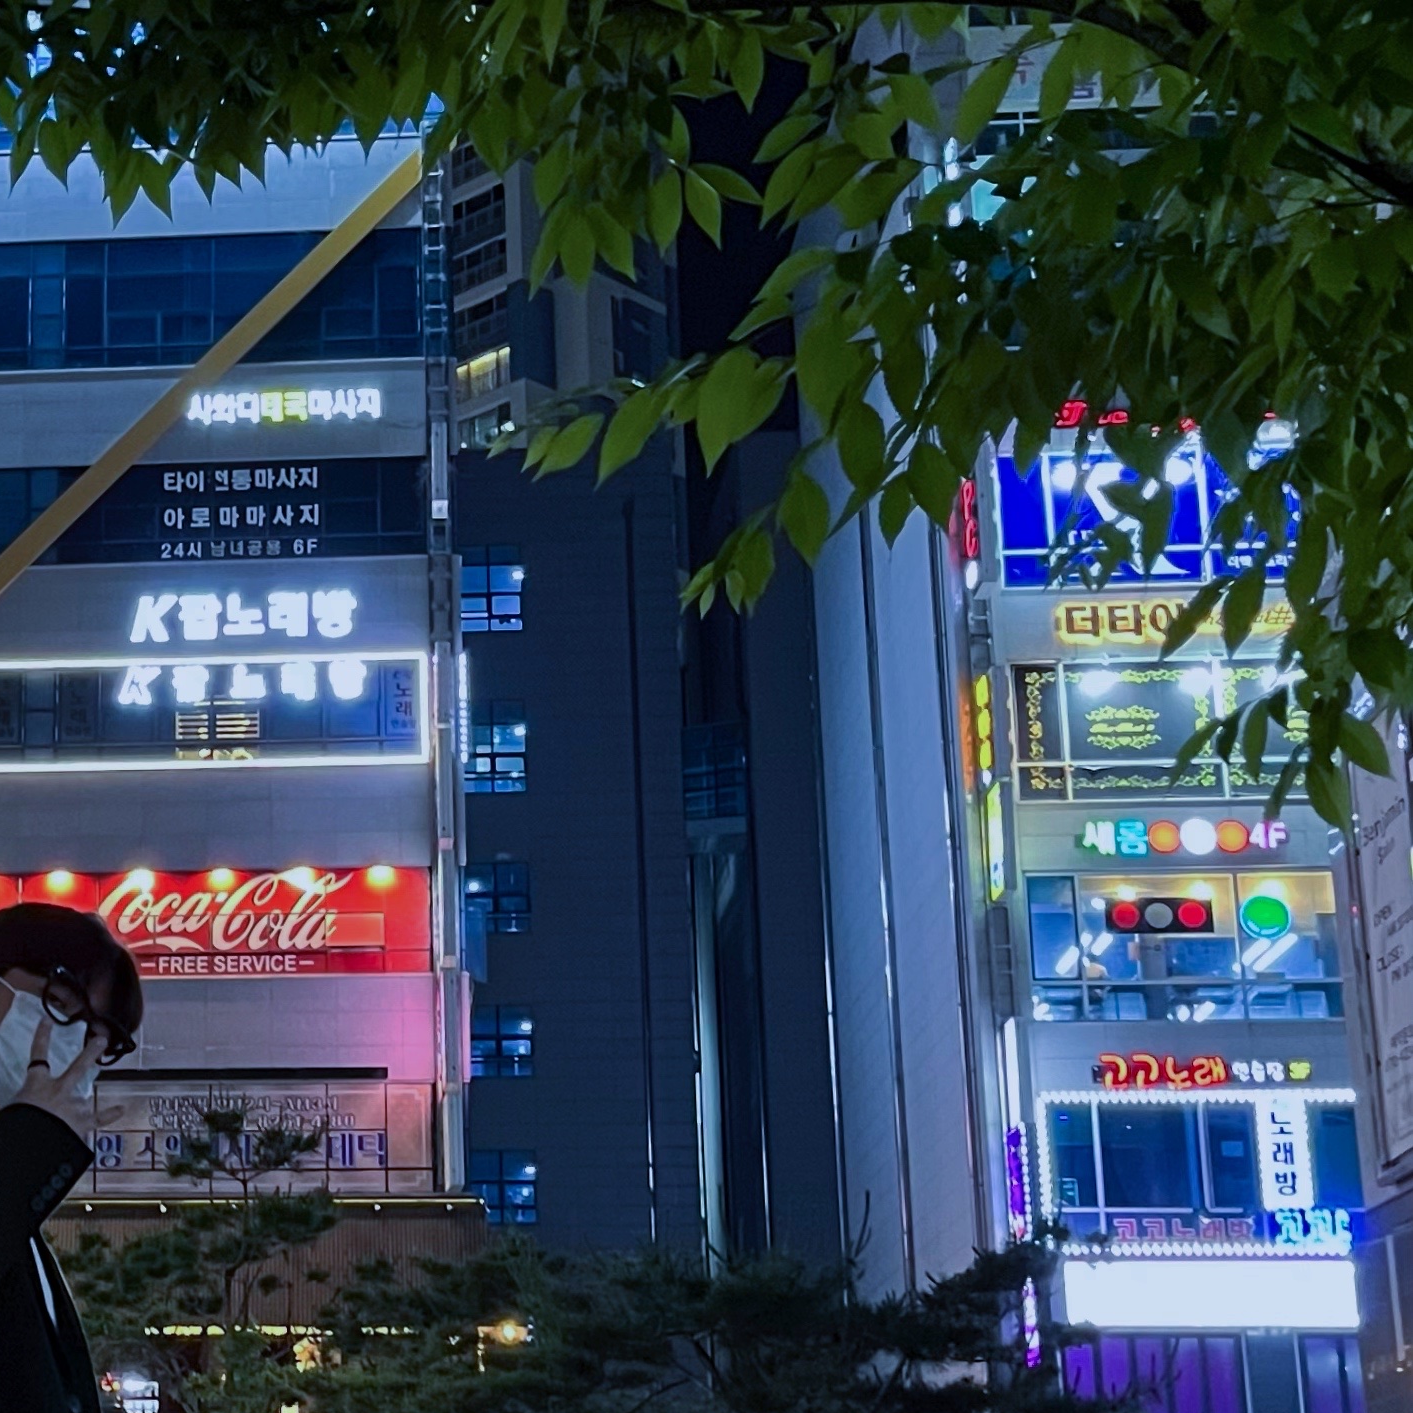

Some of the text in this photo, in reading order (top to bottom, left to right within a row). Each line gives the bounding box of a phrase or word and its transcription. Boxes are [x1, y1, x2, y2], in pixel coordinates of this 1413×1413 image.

[163, 470, 205, 493] 타이
[163, 503, 320, 530] 아로마마사지
[160, 540, 203, 560] 24시
[293, 537, 318, 556] 6F
[158, 954, 297, 974] FREE SERVICE
